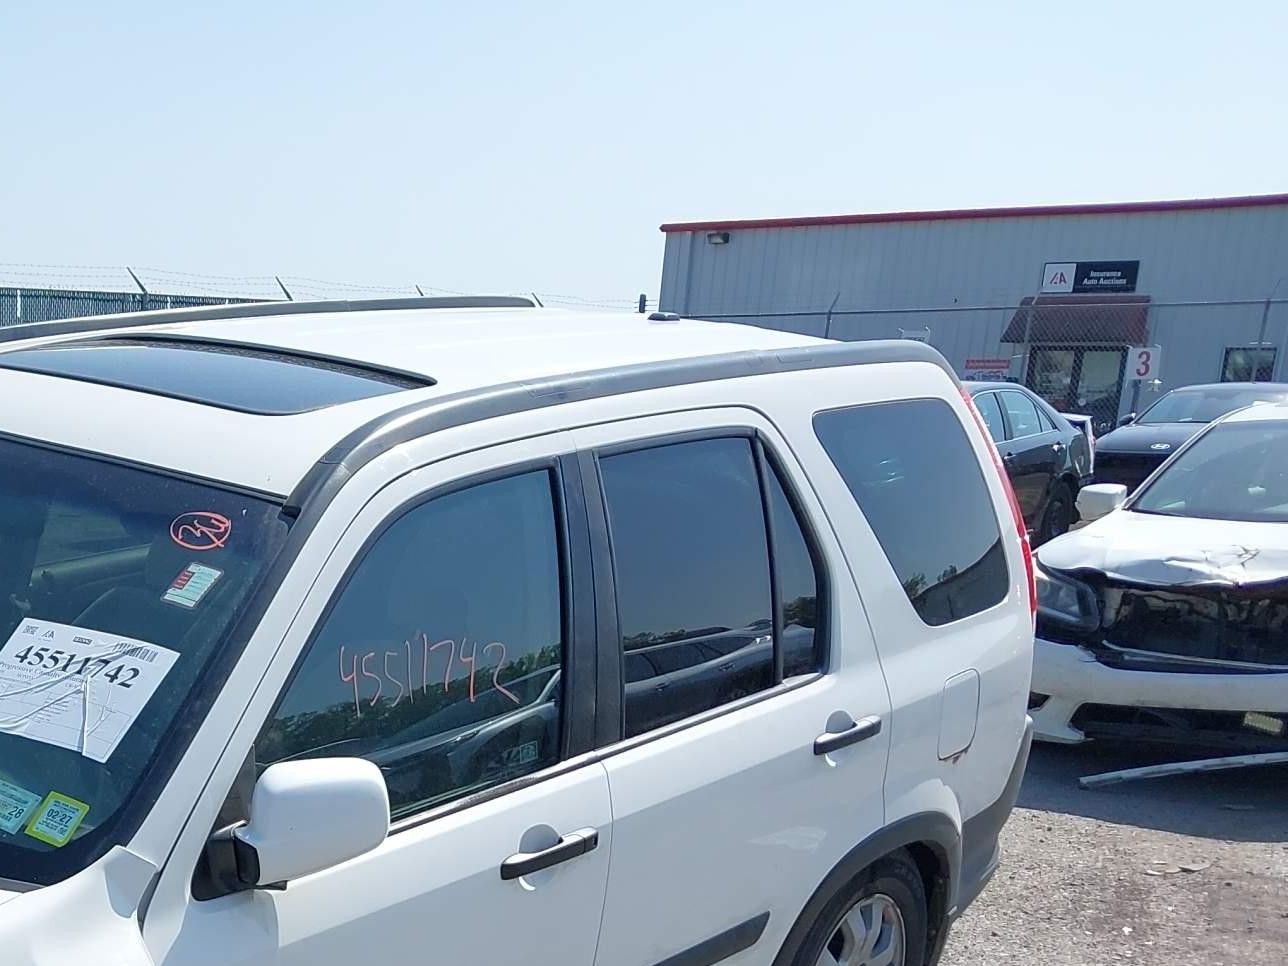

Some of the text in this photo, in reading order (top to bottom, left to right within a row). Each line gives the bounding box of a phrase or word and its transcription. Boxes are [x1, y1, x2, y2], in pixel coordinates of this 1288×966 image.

[1135, 351, 1151, 377] 3
[14, 645, 140, 689] 45511742
[339, 633, 521, 718] 45511742
[7, 805, 25, 819] 28
